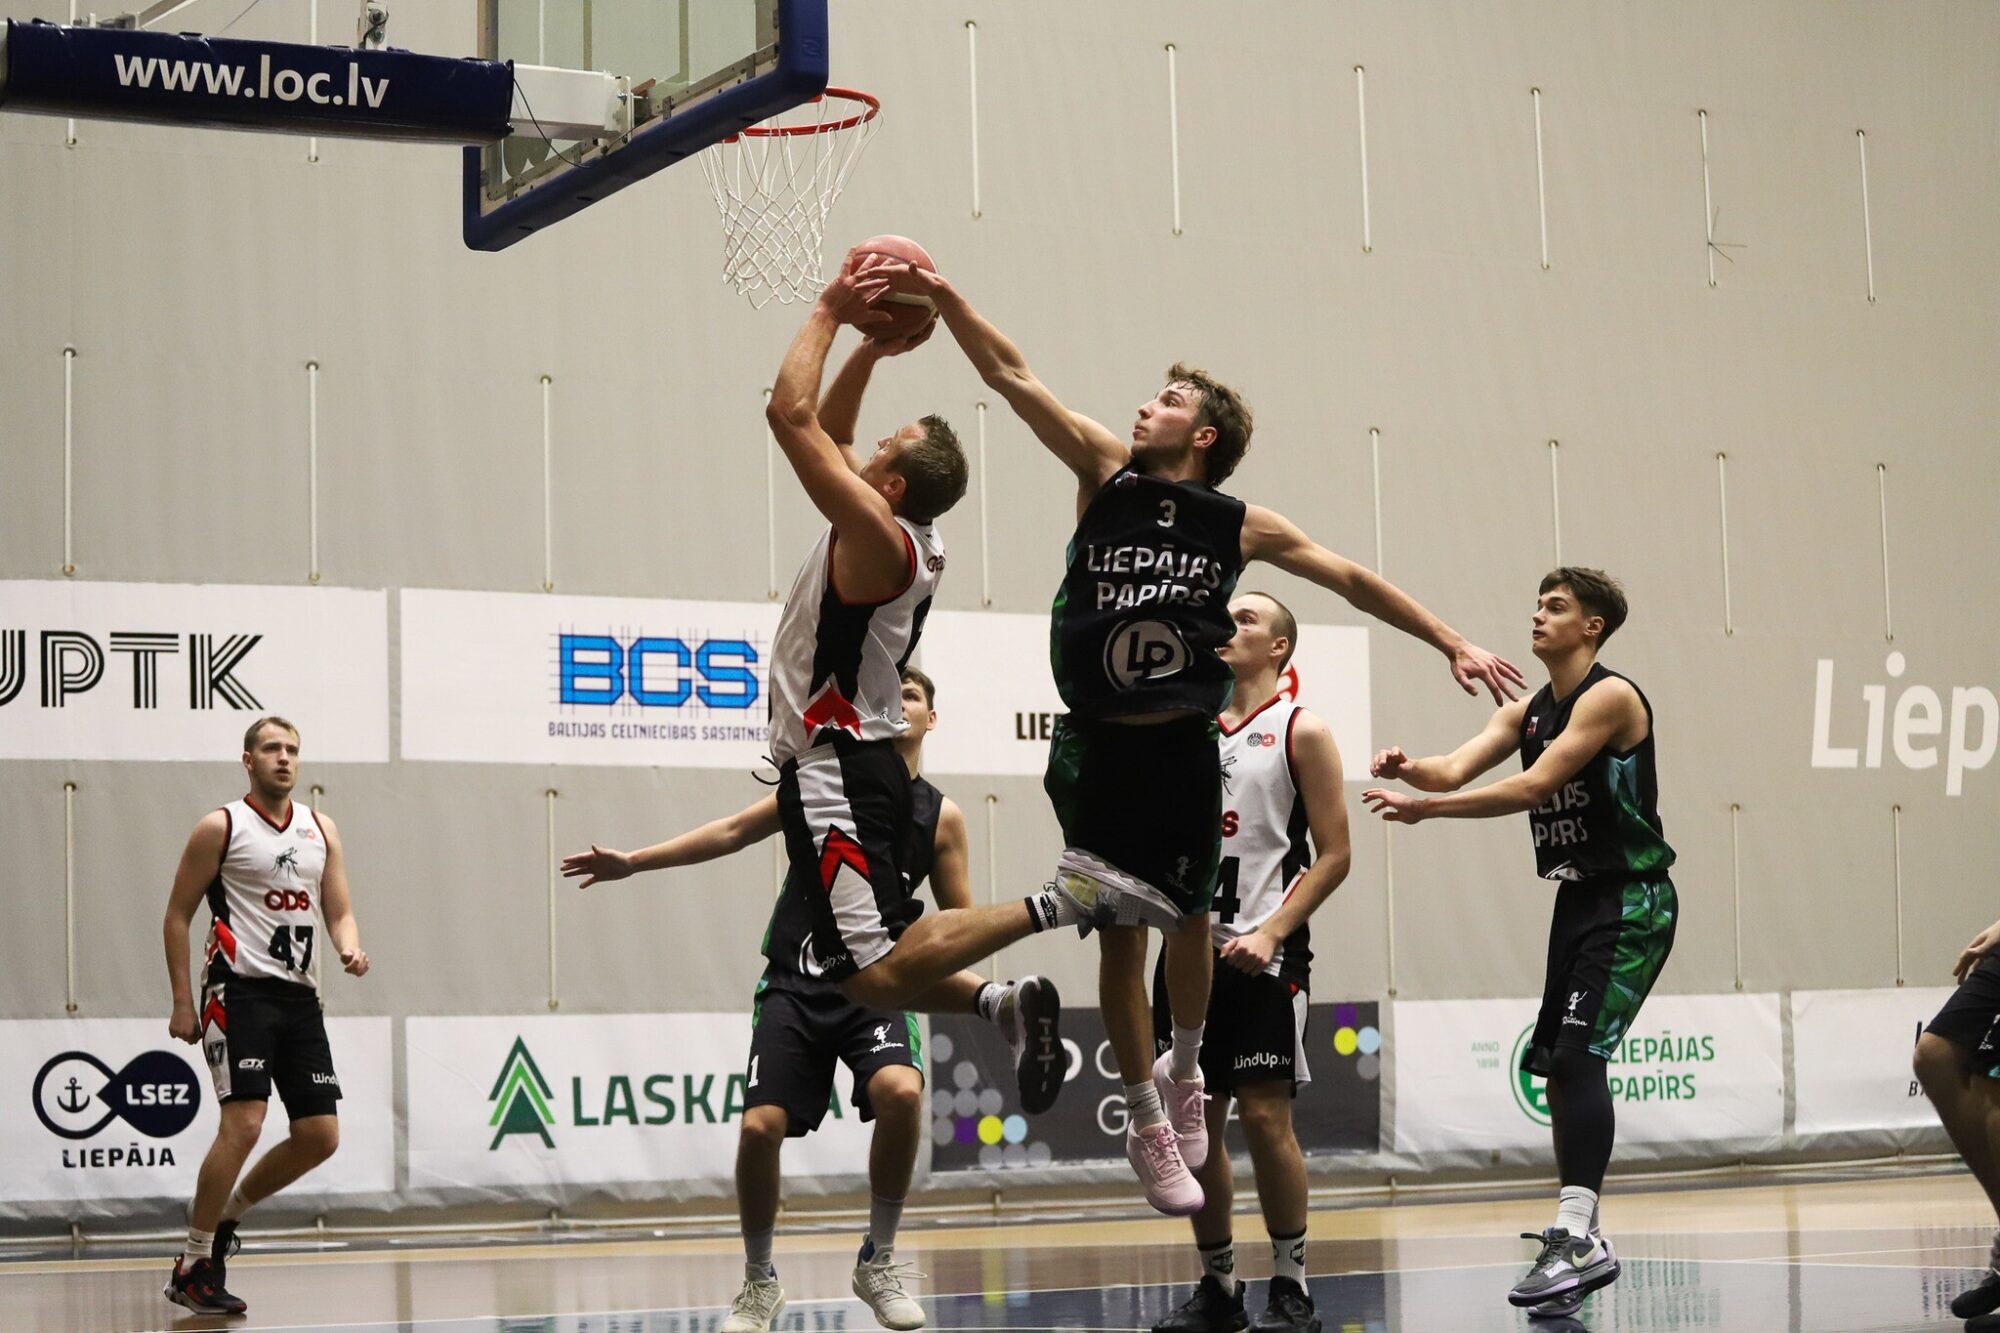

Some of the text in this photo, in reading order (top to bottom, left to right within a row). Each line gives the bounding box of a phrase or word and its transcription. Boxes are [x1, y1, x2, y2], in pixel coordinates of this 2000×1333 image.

[114, 54, 389, 108] www.loc.lv
[1156, 499, 1177, 528] 3
[1087, 543, 1222, 589] LIEPĀJAS
[1097, 579, 1210, 610] PAPĪRS
[559, 634, 759, 709] BCS
[548, 721, 606, 738] BALTIJAS
[702, 726, 769, 741] SASTATNES
[1016, 712, 1066, 740] LIE
[264, 890, 310, 911] ODS
[268, 925, 314, 974] 47
[748, 1055, 759, 1088] 1
[1609, 1069, 1696, 1102] PAPĪRS
[126, 1084, 190, 1106] LSEZ
[62, 1142, 175, 1168] LIEPĀJA
